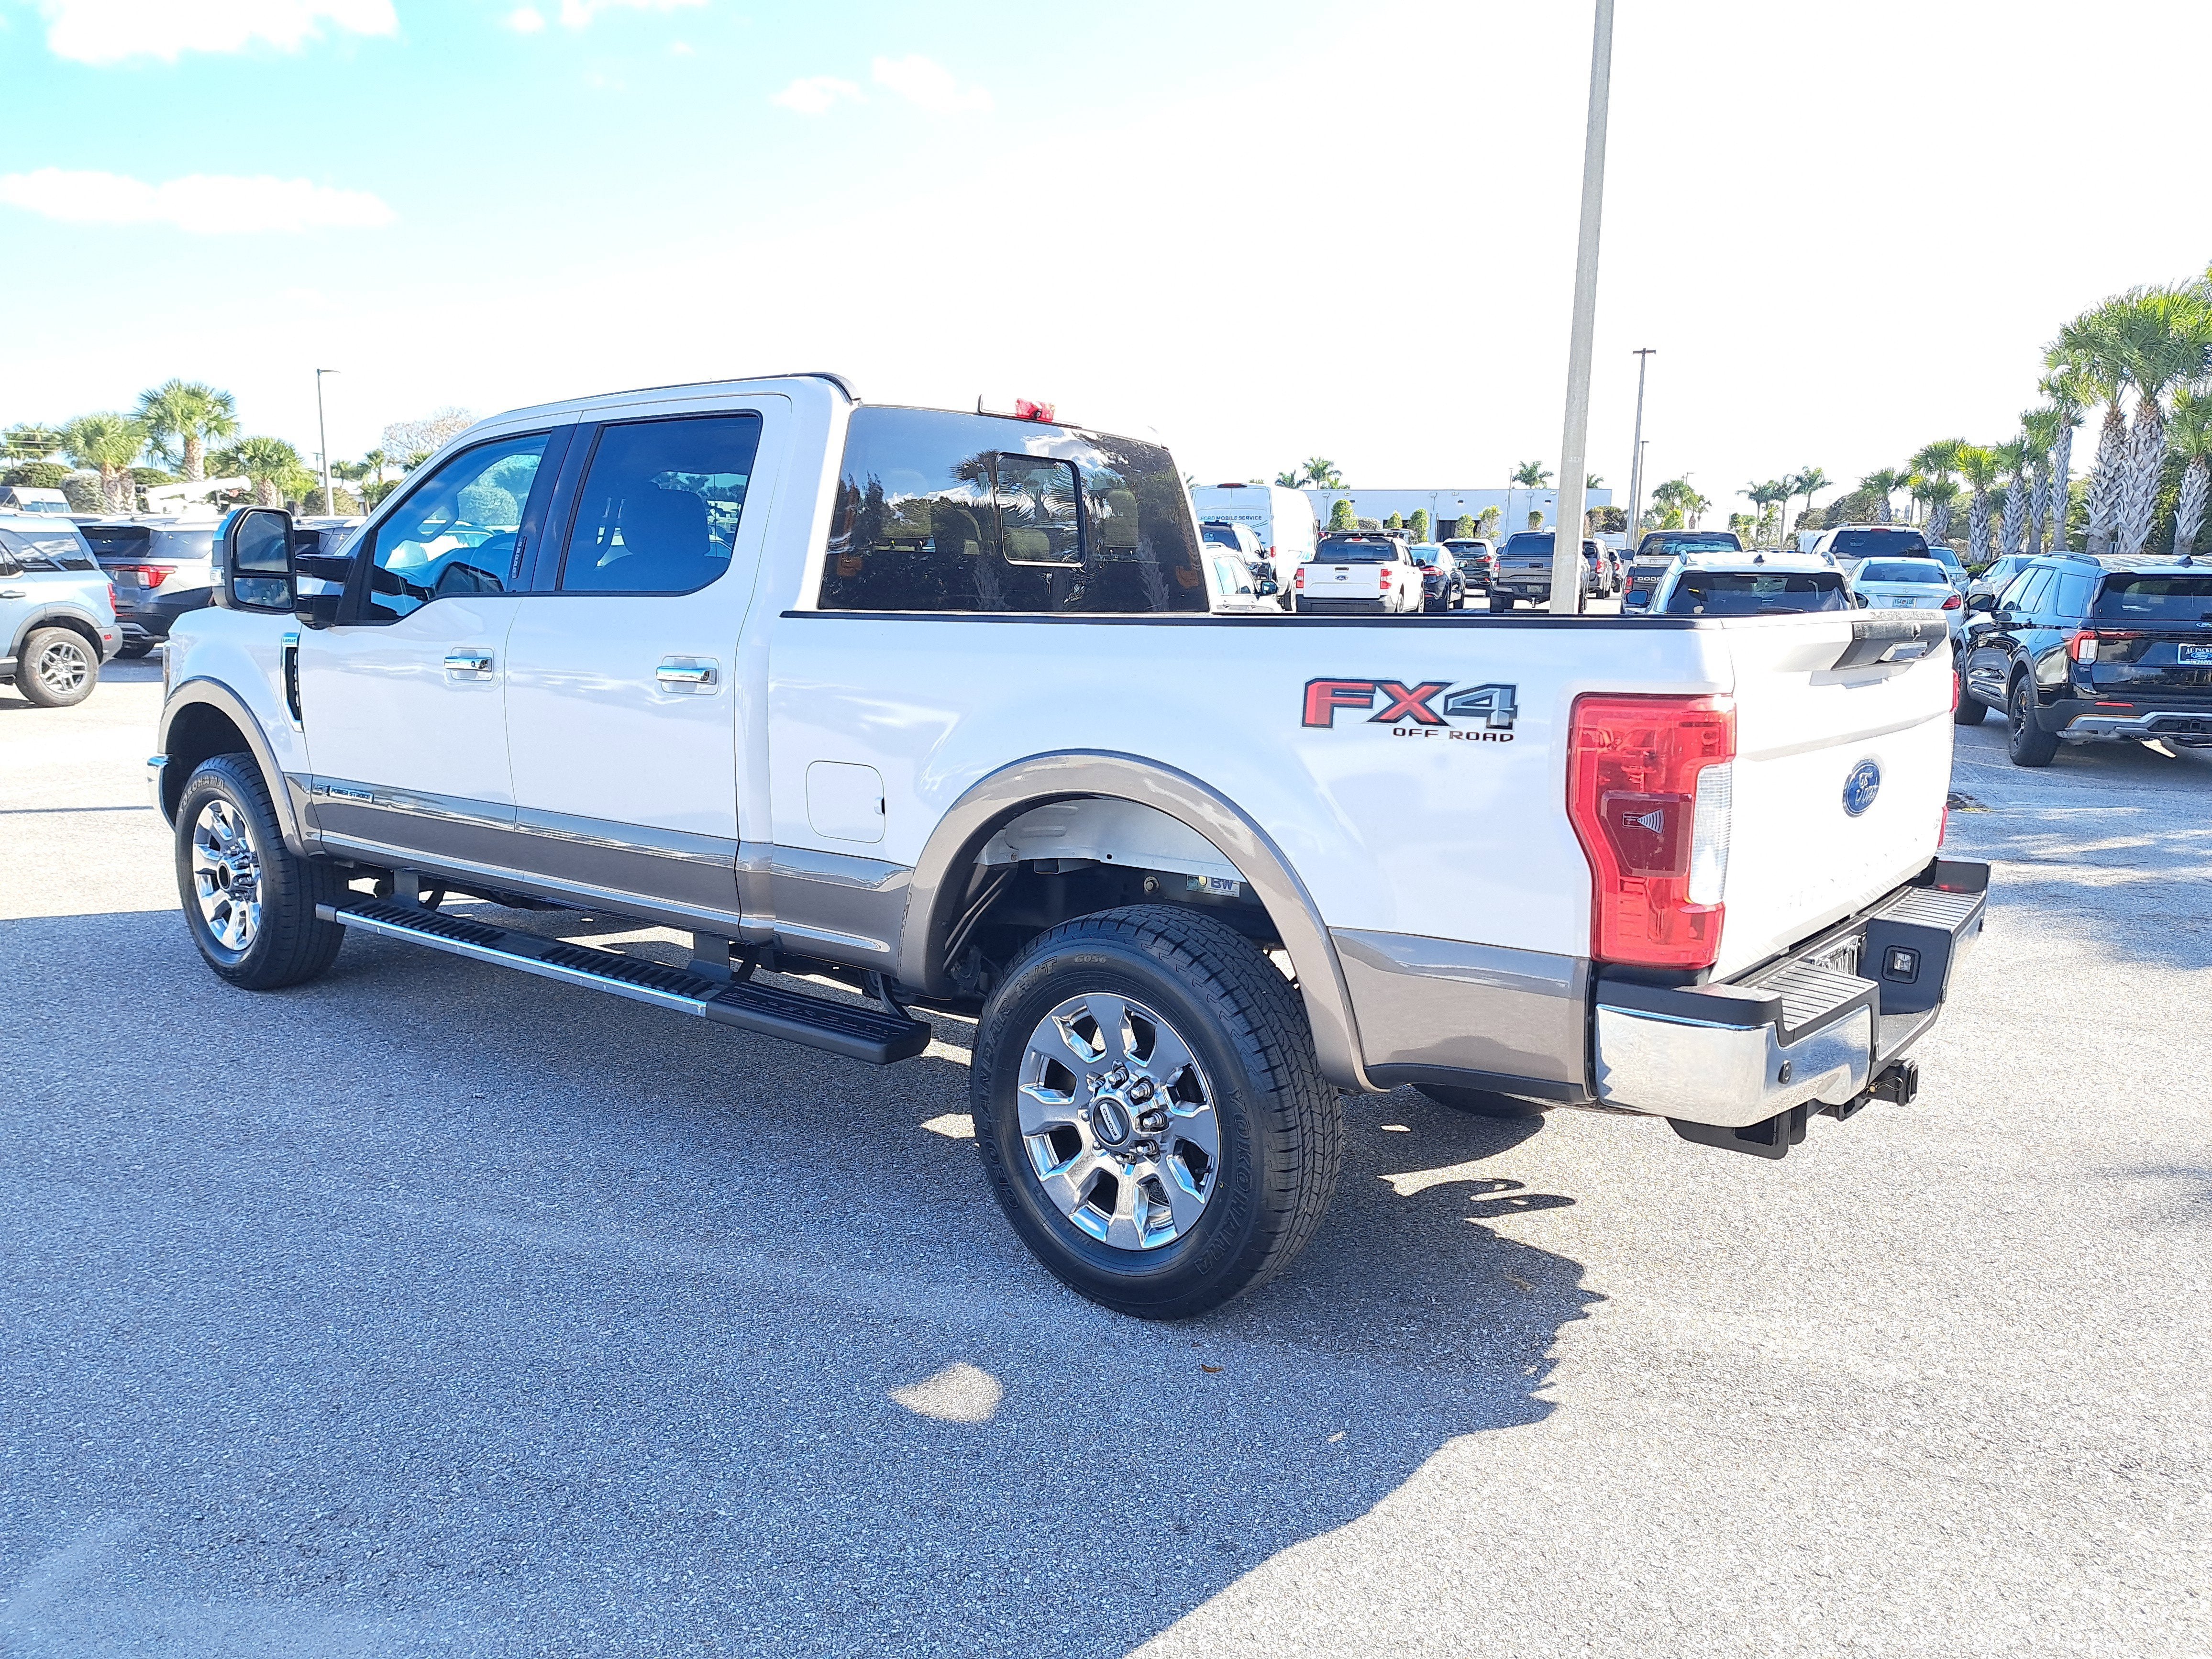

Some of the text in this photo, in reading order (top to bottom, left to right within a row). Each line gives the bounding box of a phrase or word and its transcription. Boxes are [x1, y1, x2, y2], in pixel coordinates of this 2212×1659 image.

[1302, 678, 1518, 730] FX4
[1393, 728, 1514, 742] OFF ROAD
[1855, 771, 1879, 806] Ford
[1103, 1108, 1117, 1137] FORD
[1194, 1086, 1253, 1275] YOKOHAMA
